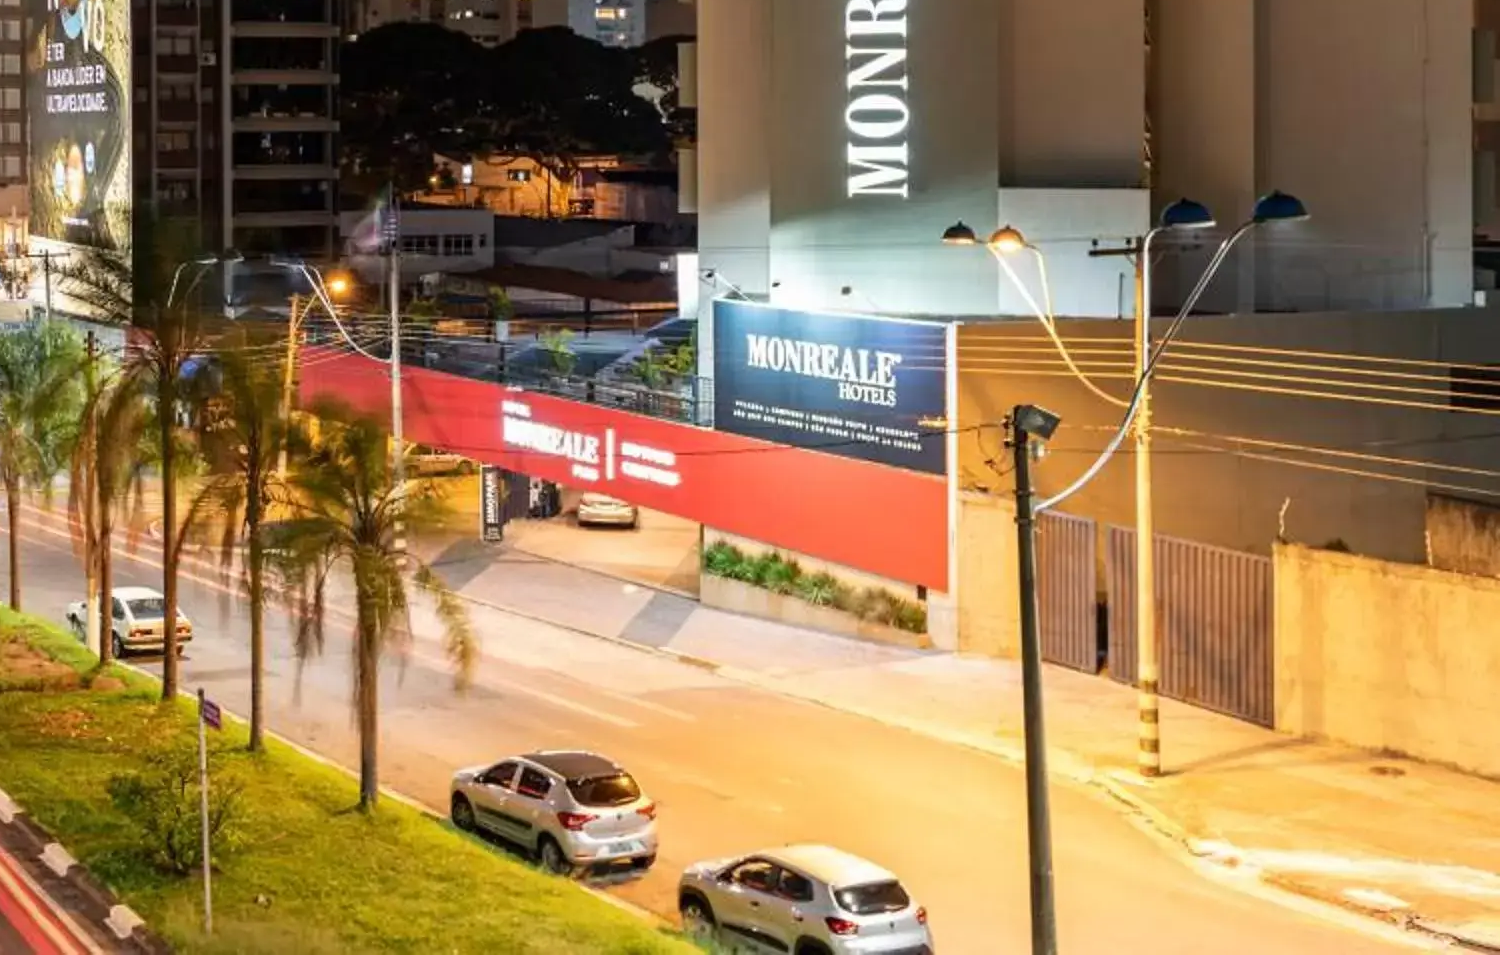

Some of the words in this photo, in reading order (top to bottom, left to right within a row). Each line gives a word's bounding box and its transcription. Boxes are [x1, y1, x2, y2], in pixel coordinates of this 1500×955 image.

[746, 334, 896, 388] MONREALE
[838, 382, 897, 408] HOTELS
[503, 416, 599, 464] REALE
